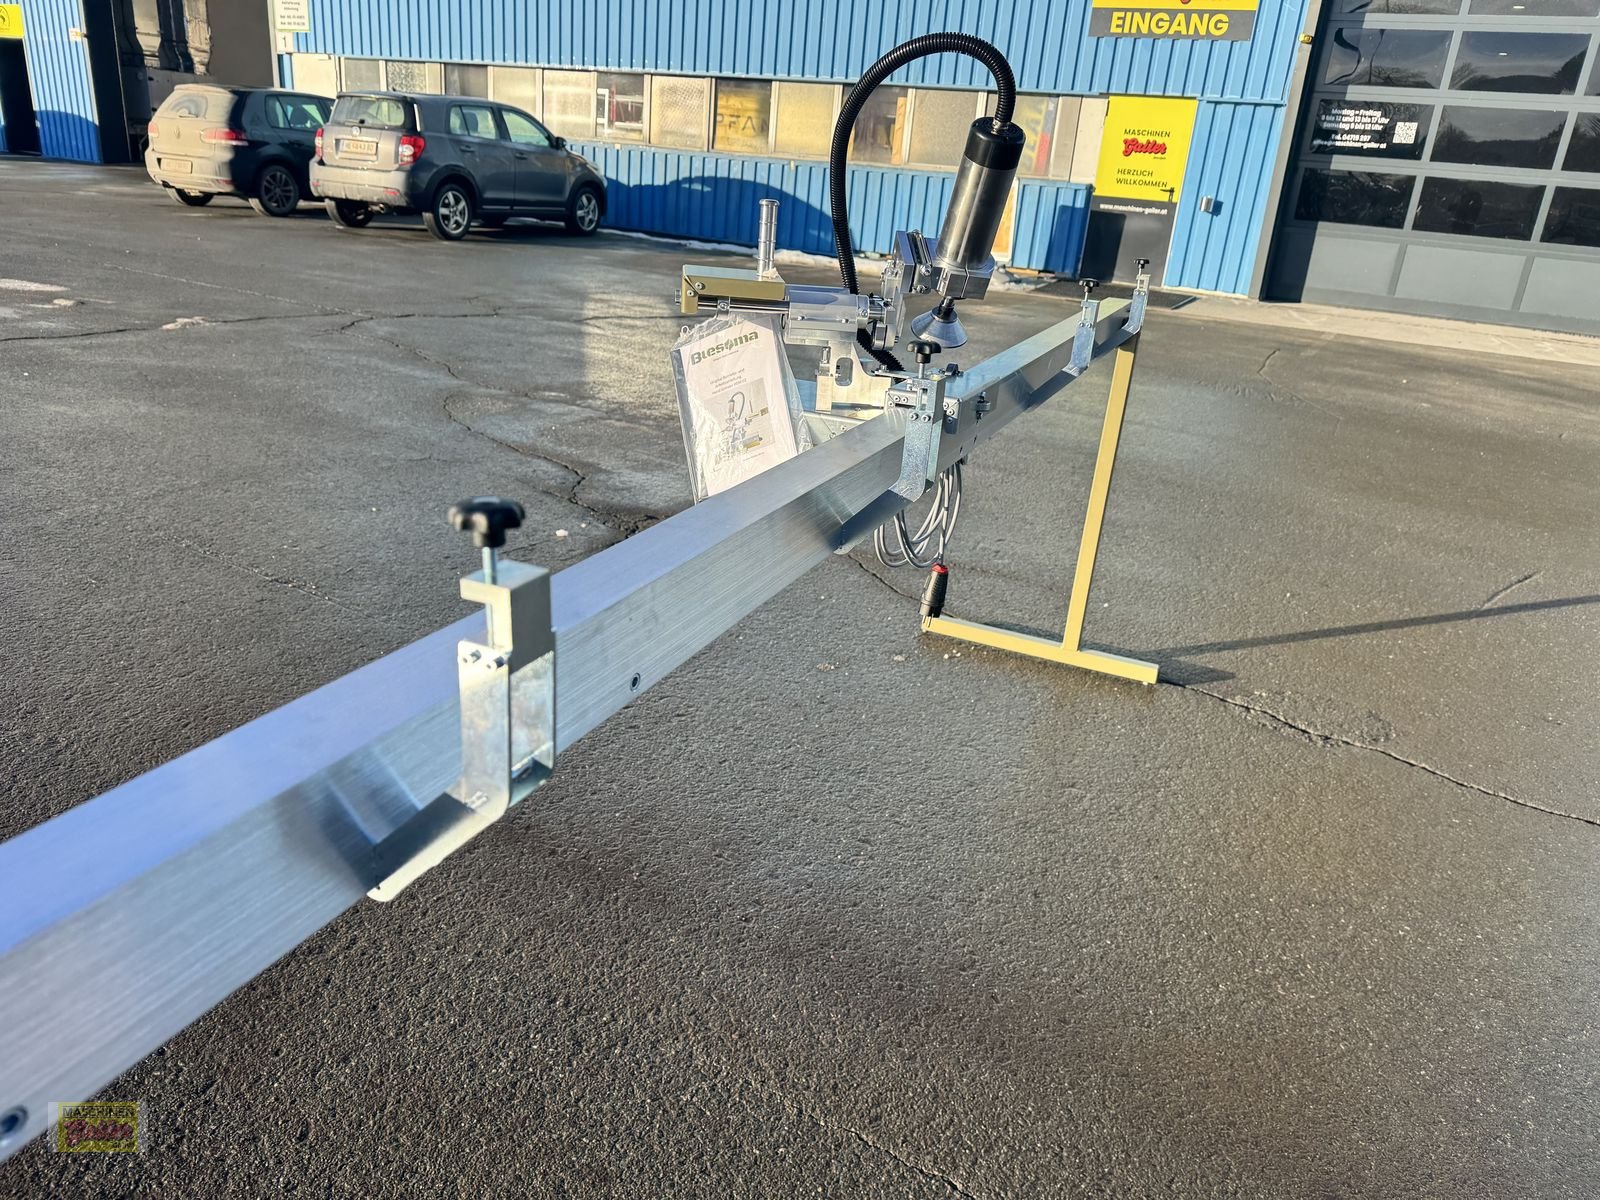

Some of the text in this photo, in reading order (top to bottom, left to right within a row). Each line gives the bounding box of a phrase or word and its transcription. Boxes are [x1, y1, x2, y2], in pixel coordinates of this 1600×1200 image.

[1109, 11, 1230, 37] EINGANG
[1123, 128, 1171, 138] MASCHINEN
[1117, 168, 1154, 177] HERZLICH
[1115, 177, 1168, 188] WILLKOMMEN
